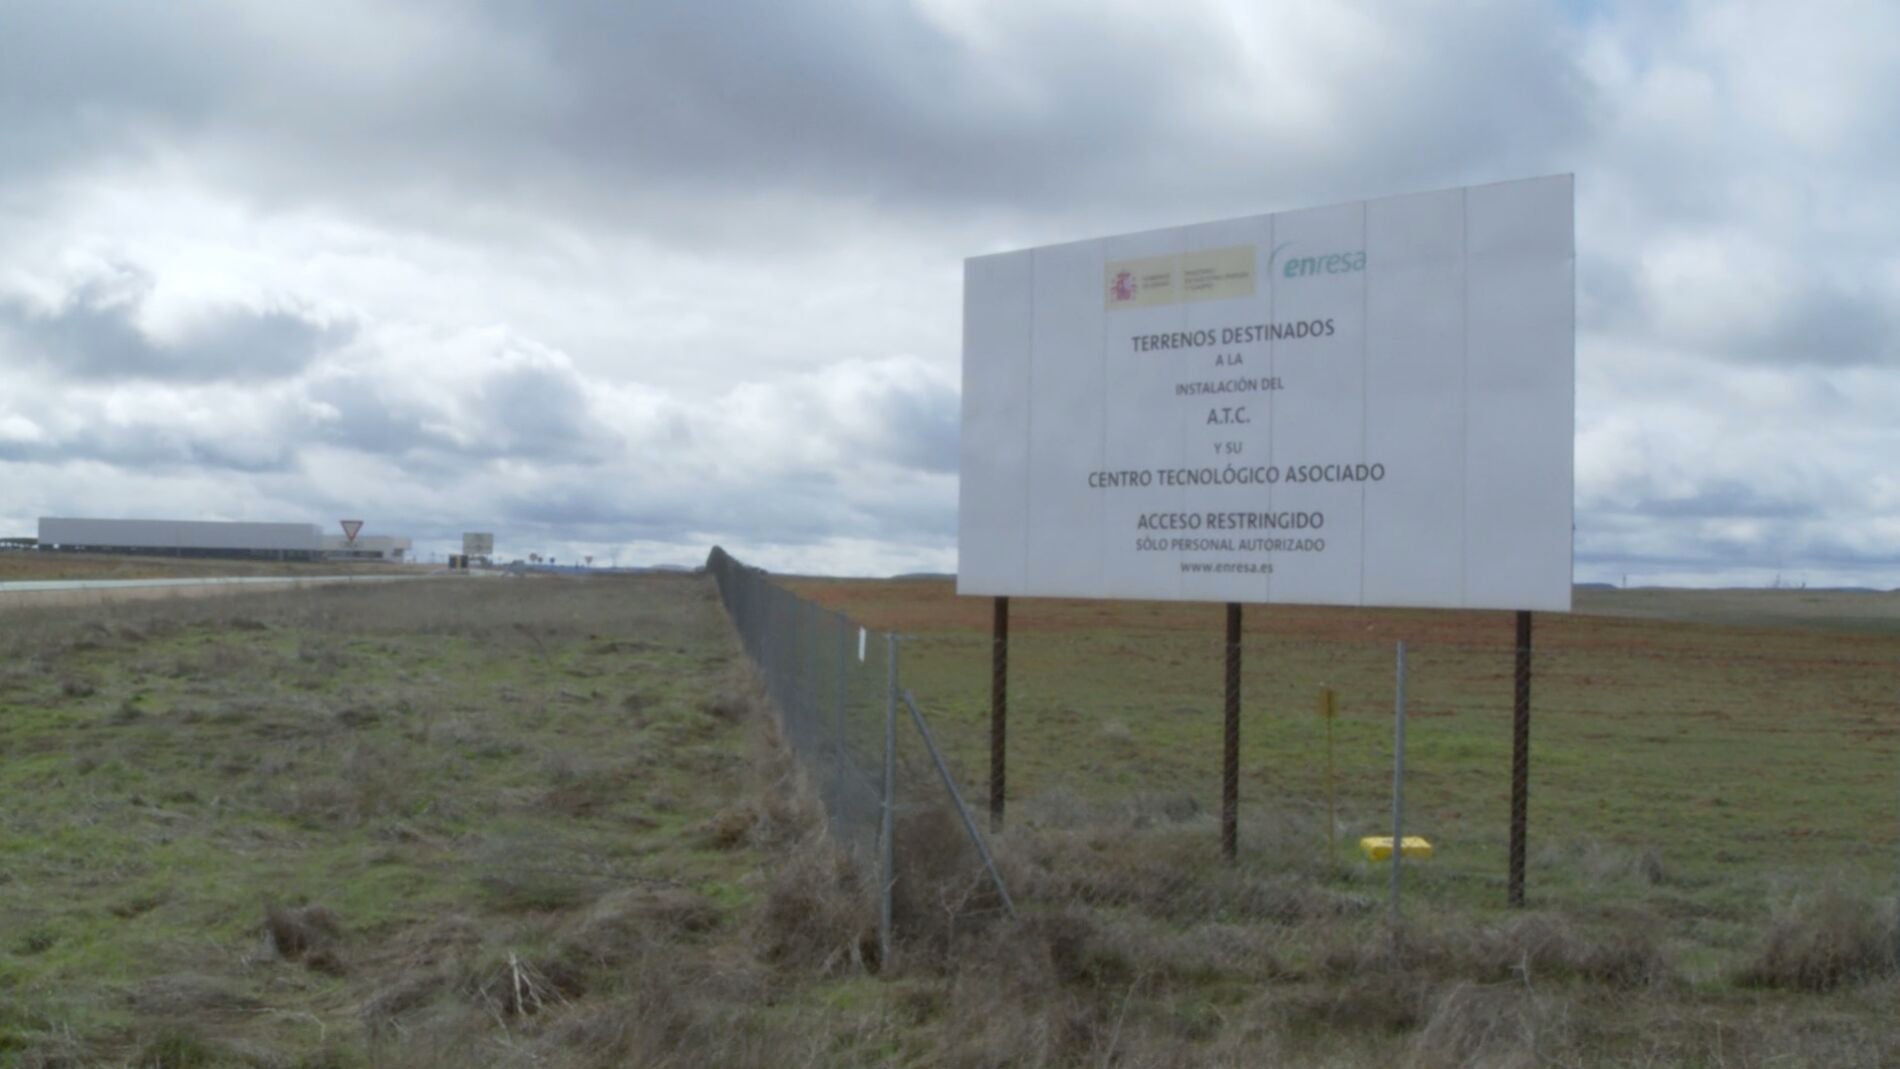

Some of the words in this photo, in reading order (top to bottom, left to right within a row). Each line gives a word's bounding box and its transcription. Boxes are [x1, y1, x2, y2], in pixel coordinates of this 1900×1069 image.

[1283, 251, 1366, 278] enresa
[1131, 329, 1216, 352] TERRENOS
[1222, 319, 1335, 345] DESTINADOS
[1216, 355, 1224, 366] A
[1228, 353, 1243, 366] LA
[1176, 377, 1257, 396] INSTALACIÓN
[1261, 377, 1284, 391] DEL
[1206, 407, 1251, 425] A.T.C.
[1214, 443, 1222, 454] Y
[1225, 442, 1243, 454] SU
[1088, 470, 1152, 488] CENTRO
[1157, 464, 1279, 486] TECNOLÓGICO
[1285, 463, 1385, 482] ASOCIADO
[1137, 513, 1201, 530] ACCESO
[1207, 512, 1324, 529] RESTRINGIDO
[1171, 539, 1235, 551] PERSONAL
[1239, 538, 1325, 552] AUTORIZADO
[1180, 562, 1273, 574] www.enresa.es
